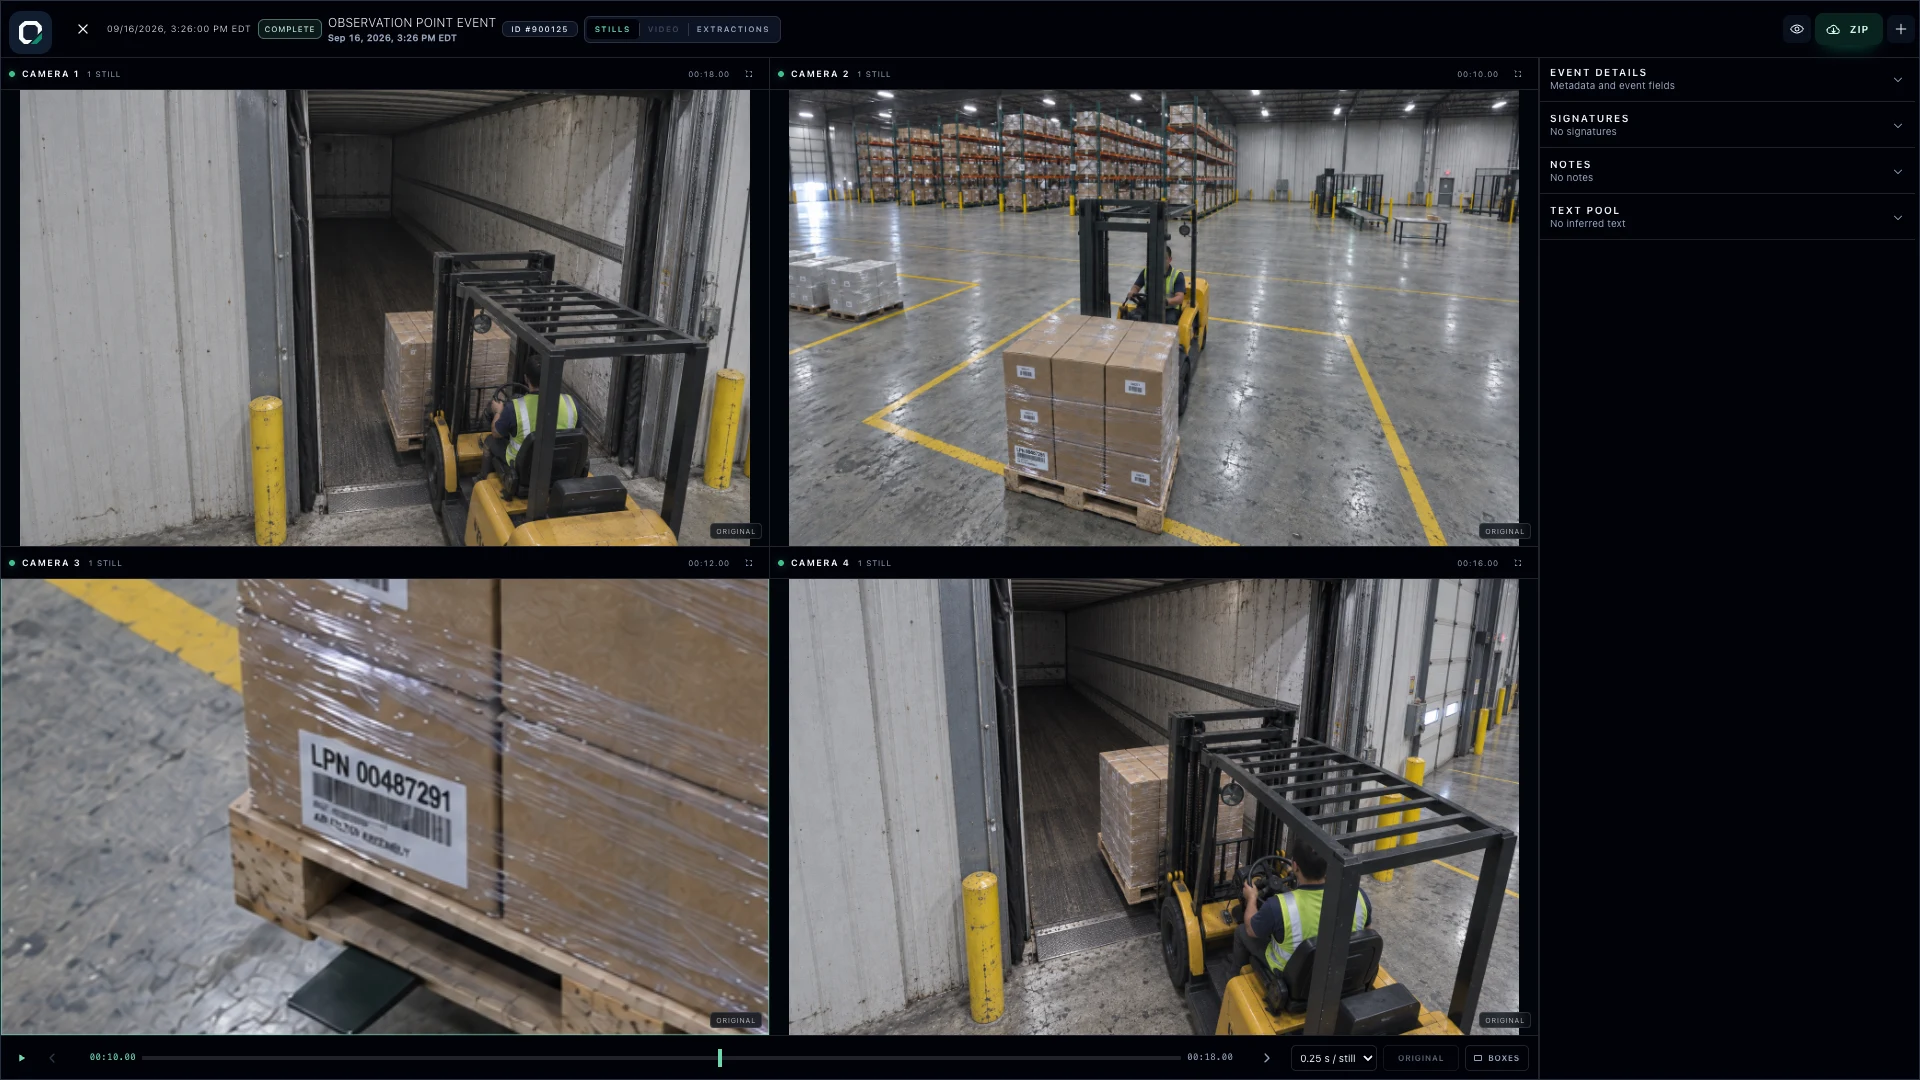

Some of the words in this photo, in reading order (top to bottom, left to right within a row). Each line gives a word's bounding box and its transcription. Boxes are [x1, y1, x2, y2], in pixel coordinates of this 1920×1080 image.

[328, 17, 412, 28] OBSERVATION
[416, 17, 454, 28] POINT
[457, 17, 497, 28] EVENT
[106, 24, 167, 35] 09/16/2026,
[170, 24, 210, 33] 3:26:00
[213, 24, 228, 33] PM
[231, 24, 251, 33] EDT
[264, 25, 315, 33] COMPLETE
[511, 25, 521, 33] ID
[524, 25, 568, 33] #900125
[594, 25, 630, 33] STILLS
[647, 25, 679, 33] VIDEO
[696, 25, 769, 33] EXTRACTIONS
[1849, 25, 1869, 34] ZIP
[327, 33, 346, 44] Sep
[348, 33, 364, 44] 16,
[366, 33, 394, 44] 2026,
[396, 33, 419, 42] 3:26
[421, 33, 436, 42] PM
[438, 33, 458, 42] EDT
[21, 69, 69, 78] CAMERA
[95, 70, 121, 78] STILL
[688, 70, 730, 78] 00:18.00
[790, 69, 838, 78] CAMERA
[865, 70, 891, 78] STILL
[1457, 70, 1499, 78] 00:10.00
[1550, 68, 1590, 77] EVENT
[1595, 68, 1647, 77] DETAILS
[1550, 81, 1596, 90] Metadata
[1598, 81, 1616, 90] and
[1618, 81, 1646, 90] event
[1648, 81, 1676, 90] fields
[1550, 114, 1629, 123] SIGNATURES
[1550, 127, 1564, 136] No
[1566, 127, 1617, 138] signatures
[1550, 160, 1591, 169] NOTES
[1550, 173, 1564, 182] No
[1566, 173, 1594, 182] notes
[1549, 206, 1581, 215] TEXT
[1586, 206, 1620, 215] POOL
[1550, 219, 1564, 228] No
[1566, 219, 1605, 228] inferred
[1606, 219, 1626, 228] text
[21, 558, 69, 567] CAMERA
[97, 559, 122, 567] STILL
[688, 559, 730, 567] 00:12.00
[790, 558, 838, 567] CAMERA
[866, 559, 891, 567] STILL
[1457, 559, 1499, 567] 00:16.00
[311, 743, 350, 777] LPN
[356, 760, 451, 812] 00487291
[89, 1052, 136, 1061] 00:10.00
[1187, 1052, 1234, 1061] 00:18.00
[1300, 1054, 1322, 1063] 0.25
[1338, 1053, 1356, 1063] still
[1397, 1054, 1444, 1062] ORIGINAL
[1488, 1054, 1520, 1062] BOXES
